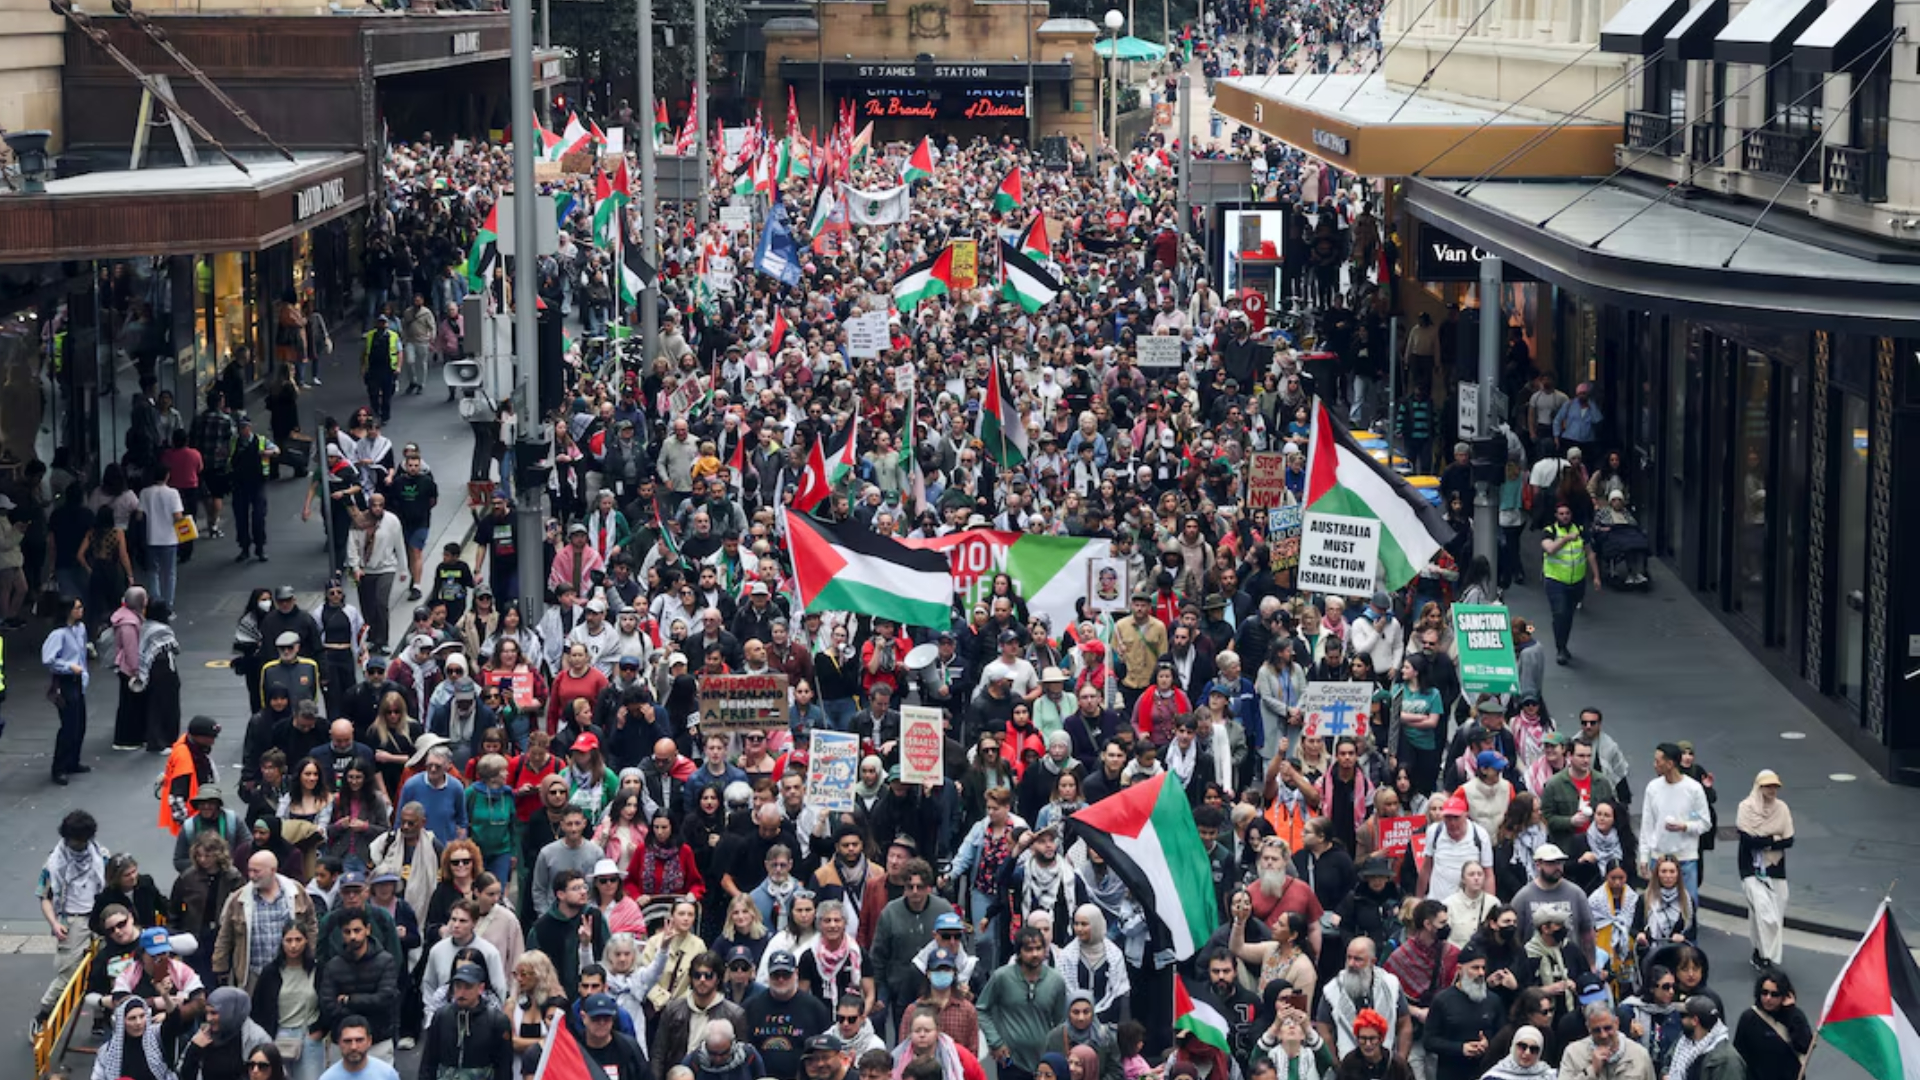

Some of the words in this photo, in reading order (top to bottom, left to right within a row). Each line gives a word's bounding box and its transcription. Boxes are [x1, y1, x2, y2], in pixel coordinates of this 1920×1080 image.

[859, 67, 874, 77] ST
[878, 67, 916, 77] JAMES
[935, 67, 988, 77] STATION
[864, 98, 885, 116] The
[888, 97, 937, 119] Brandy
[1432, 244, 1467, 262] Van
[1461, 387, 1476, 405] ONE
[1255, 455, 1283, 471] STOP
[1250, 490, 1281, 507] NOW
[1310, 519, 1371, 539] AUSTRALIA
[1323, 539, 1355, 554] MUST
[1309, 554, 1366, 573] SANCTION
[1300, 570, 1338, 587] ISRAEL
[1339, 574, 1371, 591] NOW!
[1458, 613, 1508, 631] SANCTION
[1468, 631, 1504, 649] ISRAEL
[702, 690, 727, 700] NEW
[729, 690, 783, 700] ZEALAND
[705, 709, 718, 720] A
[721, 708, 756, 720] FREE
[913, 727, 932, 736] STOP
[1392, 820, 1412, 830] END
